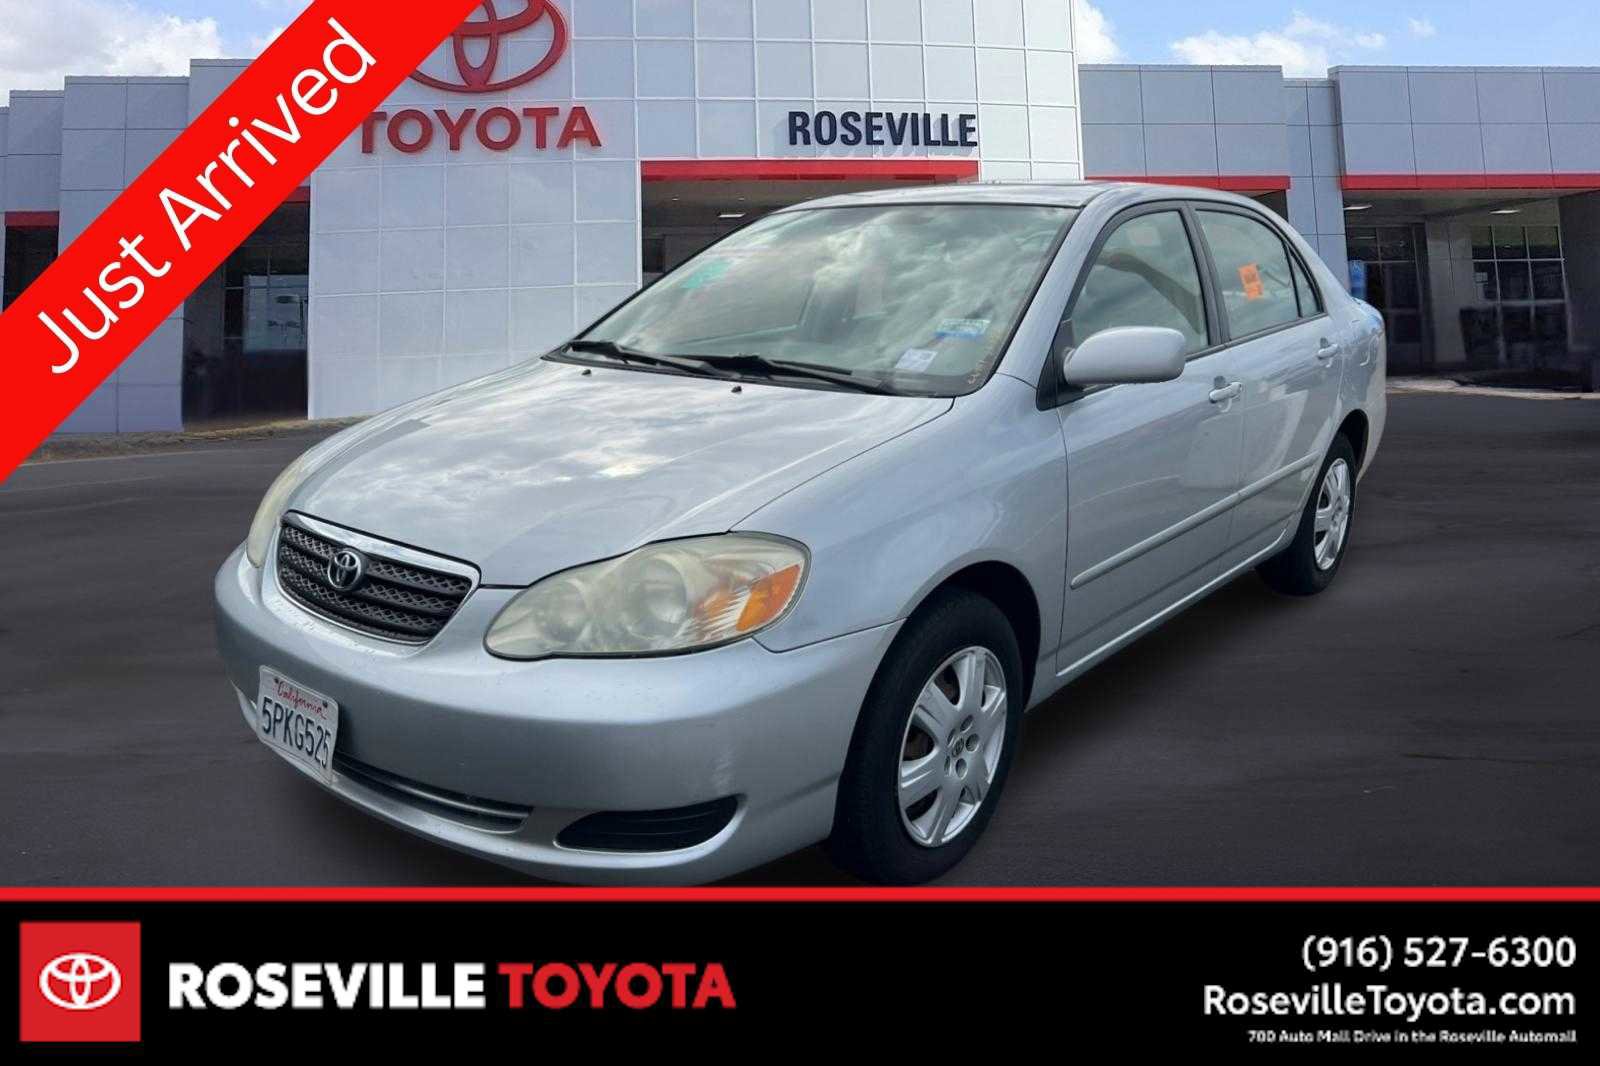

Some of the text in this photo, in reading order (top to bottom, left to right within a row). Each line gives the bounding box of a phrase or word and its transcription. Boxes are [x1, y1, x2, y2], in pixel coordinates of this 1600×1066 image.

[361, 106, 602, 154] TOYOTA
[788, 111, 978, 147] ROSEVILLE
[276, 679, 327, 720] California
[262, 696, 332, 769] 5PKG525
